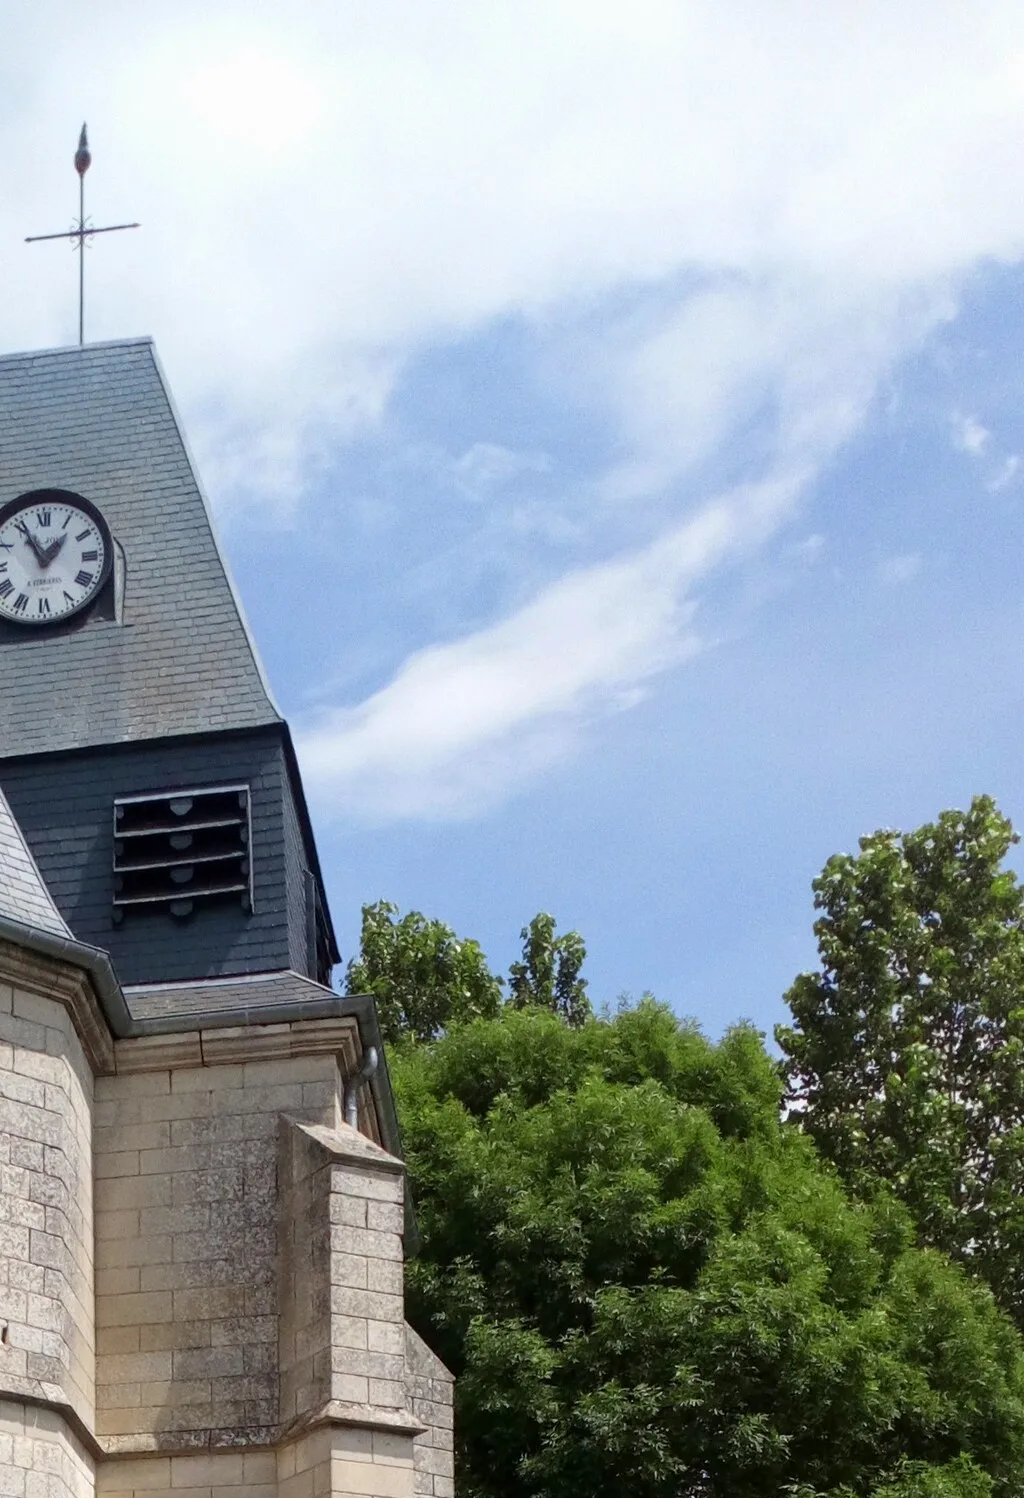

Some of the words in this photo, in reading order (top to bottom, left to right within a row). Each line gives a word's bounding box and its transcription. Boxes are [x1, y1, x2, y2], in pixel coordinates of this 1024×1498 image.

[36, 511, 51, 528] XII
[61, 514, 72, 529] I
[75, 529, 91, 542] II
[81, 550, 97, 562] III
[13, 593, 29, 612] VII
[38, 597, 51, 613] VI
[62, 590, 76, 608] V
